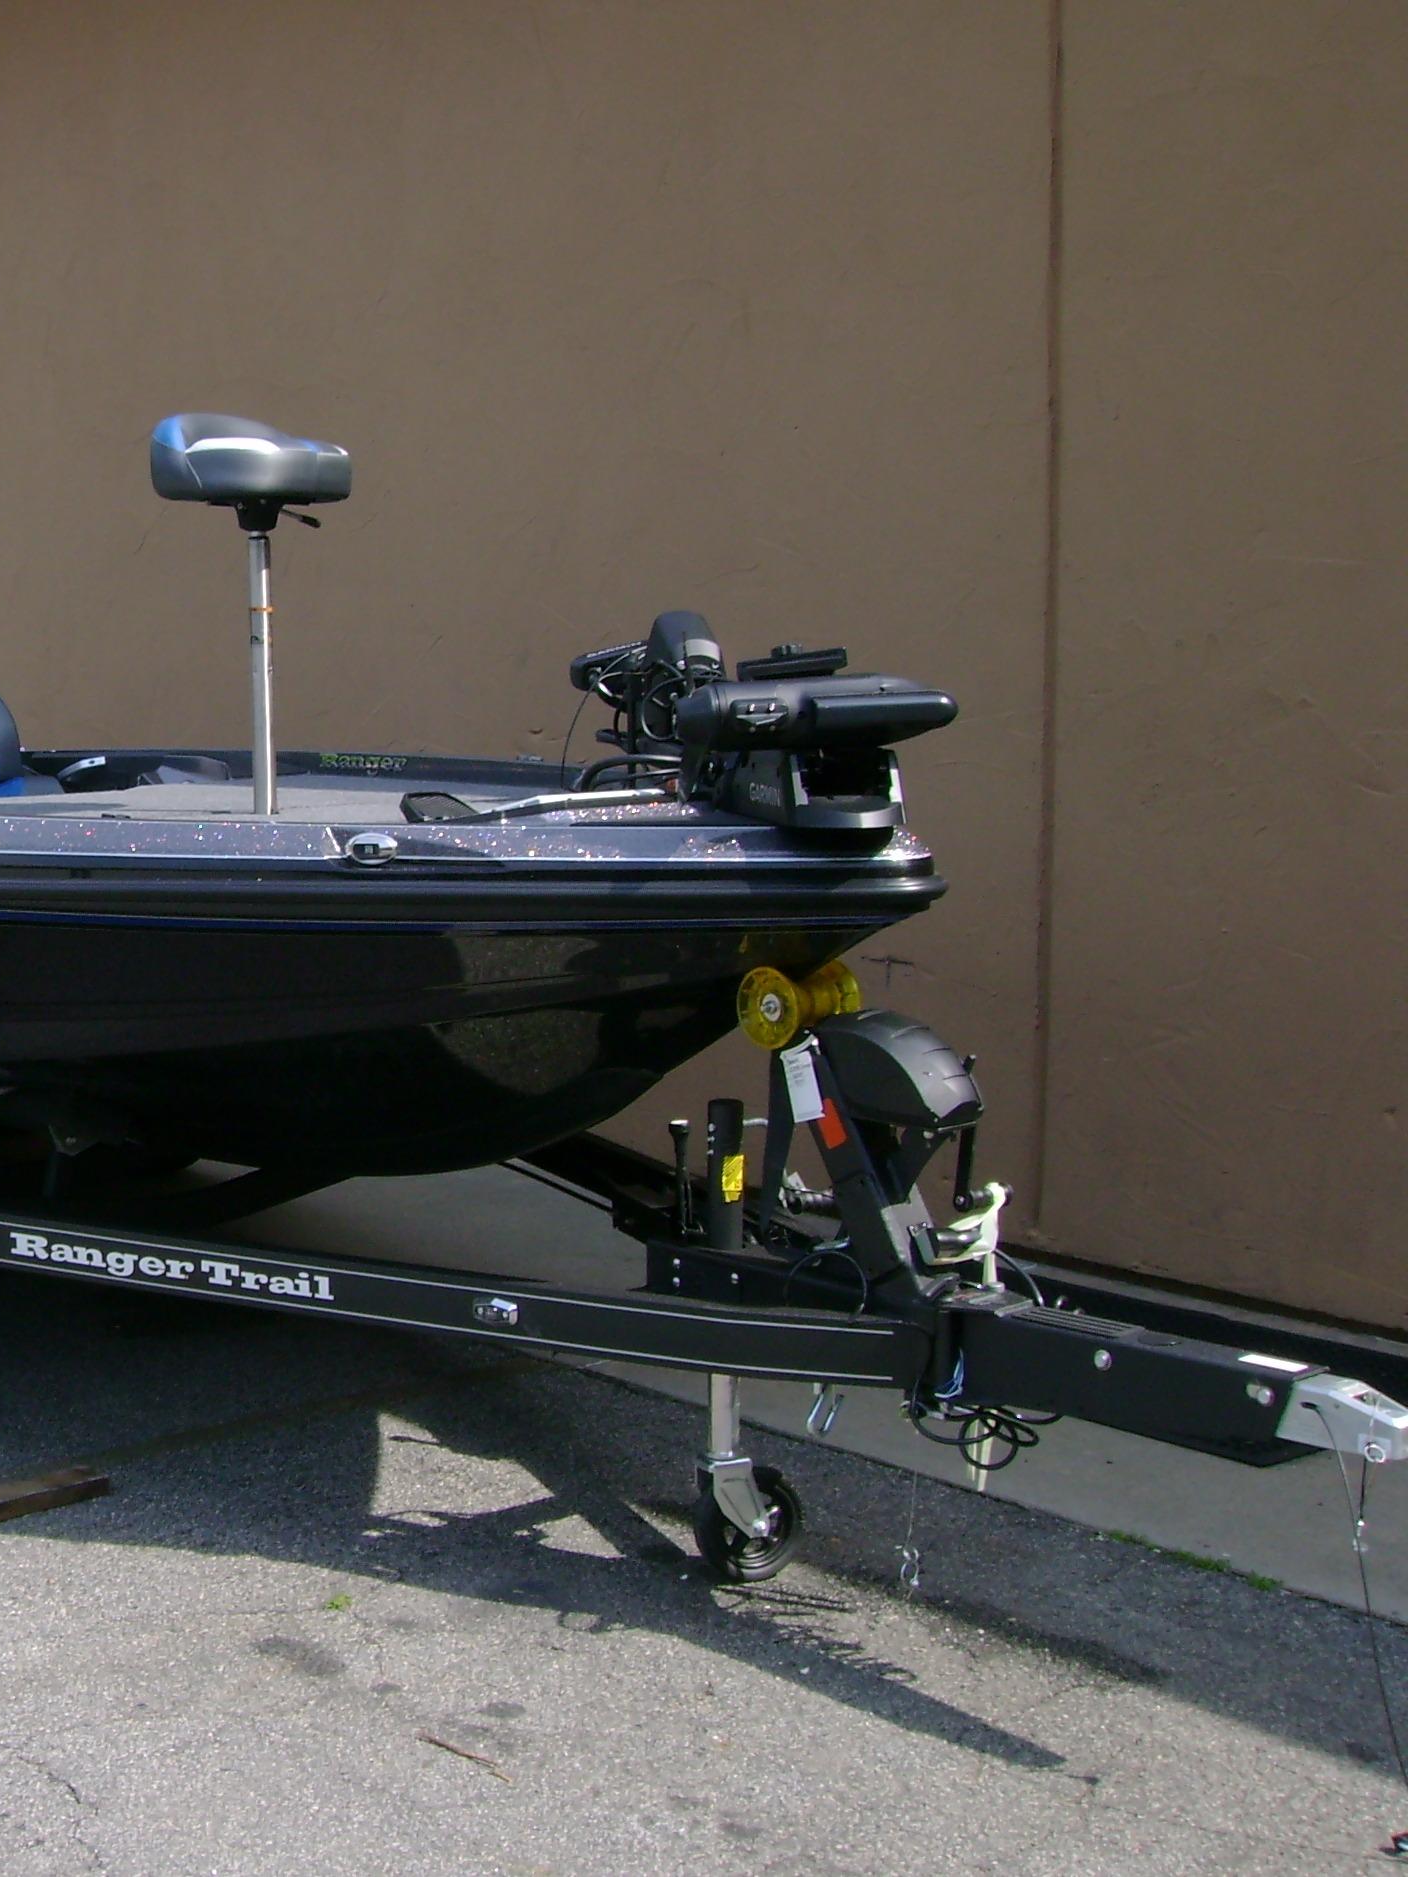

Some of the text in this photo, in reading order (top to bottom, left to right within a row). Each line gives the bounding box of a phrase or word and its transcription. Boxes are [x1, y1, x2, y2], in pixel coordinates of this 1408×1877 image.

[319, 753, 408, 775] Ranger
[9, 1231, 335, 1301] Ranger Trail
